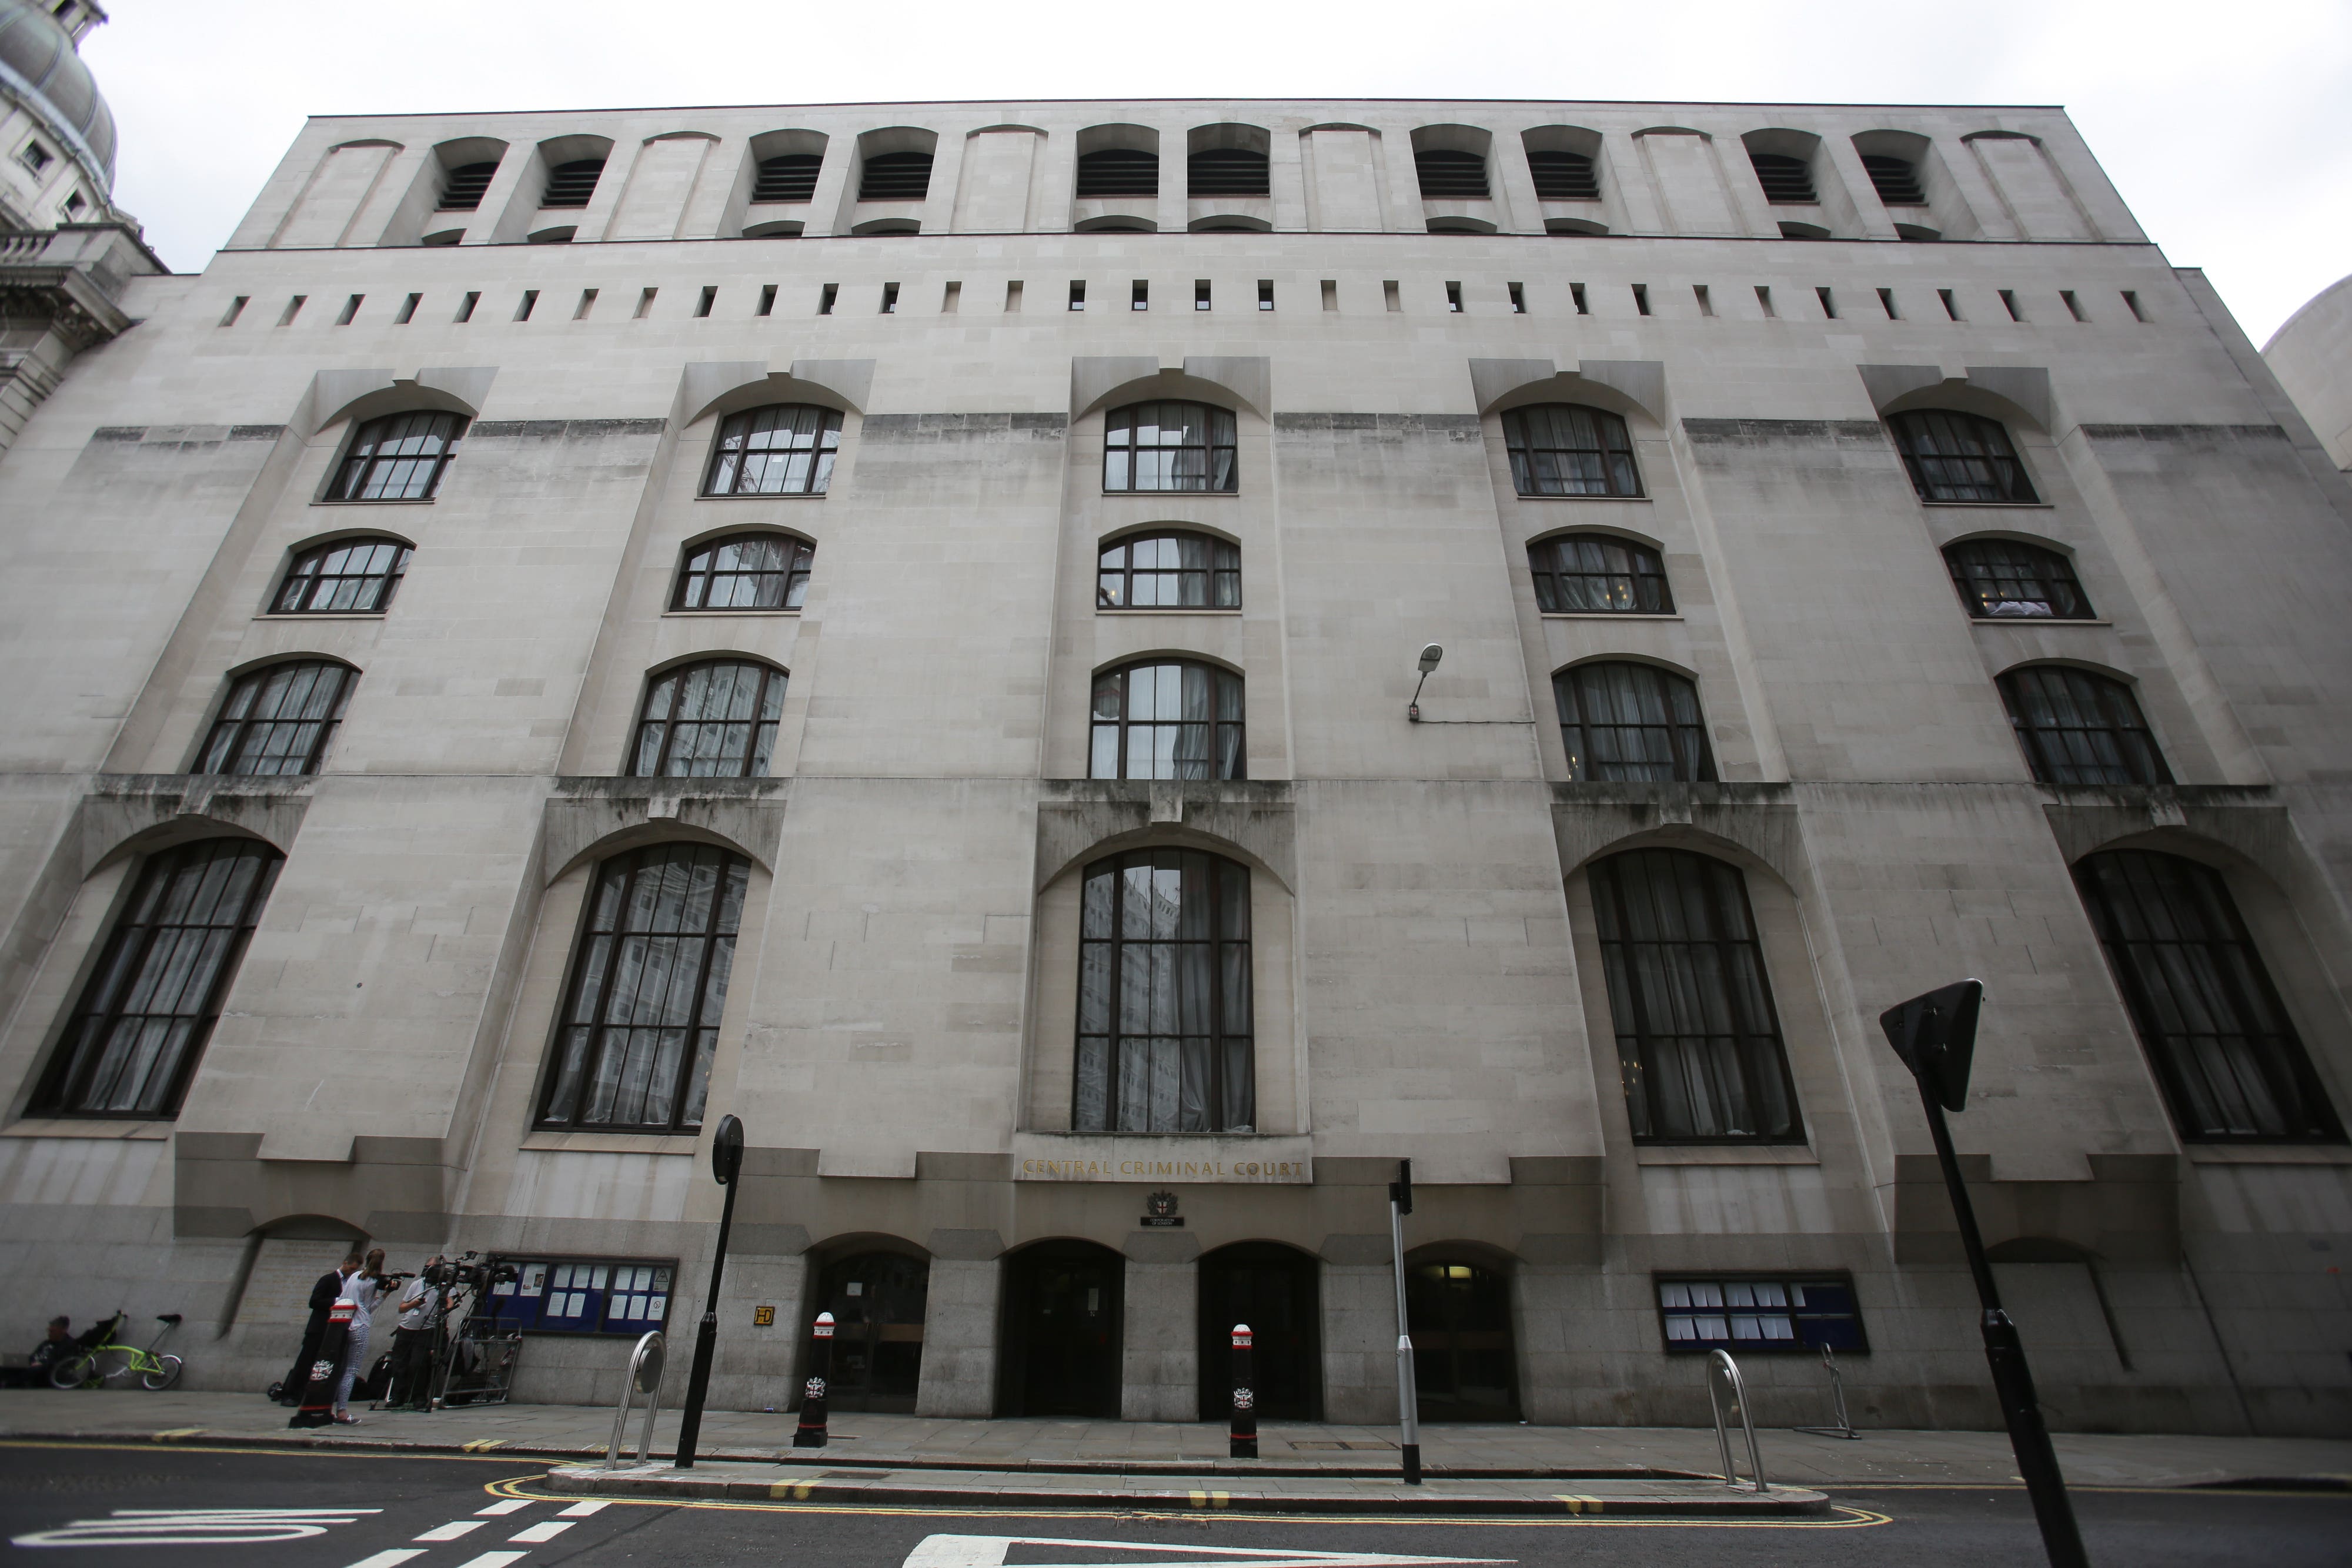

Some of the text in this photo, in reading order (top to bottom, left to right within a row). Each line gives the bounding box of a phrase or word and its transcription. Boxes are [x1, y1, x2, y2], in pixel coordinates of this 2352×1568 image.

[1023, 1159, 1303, 1176] CENTRAL CRIMINAL COURT
